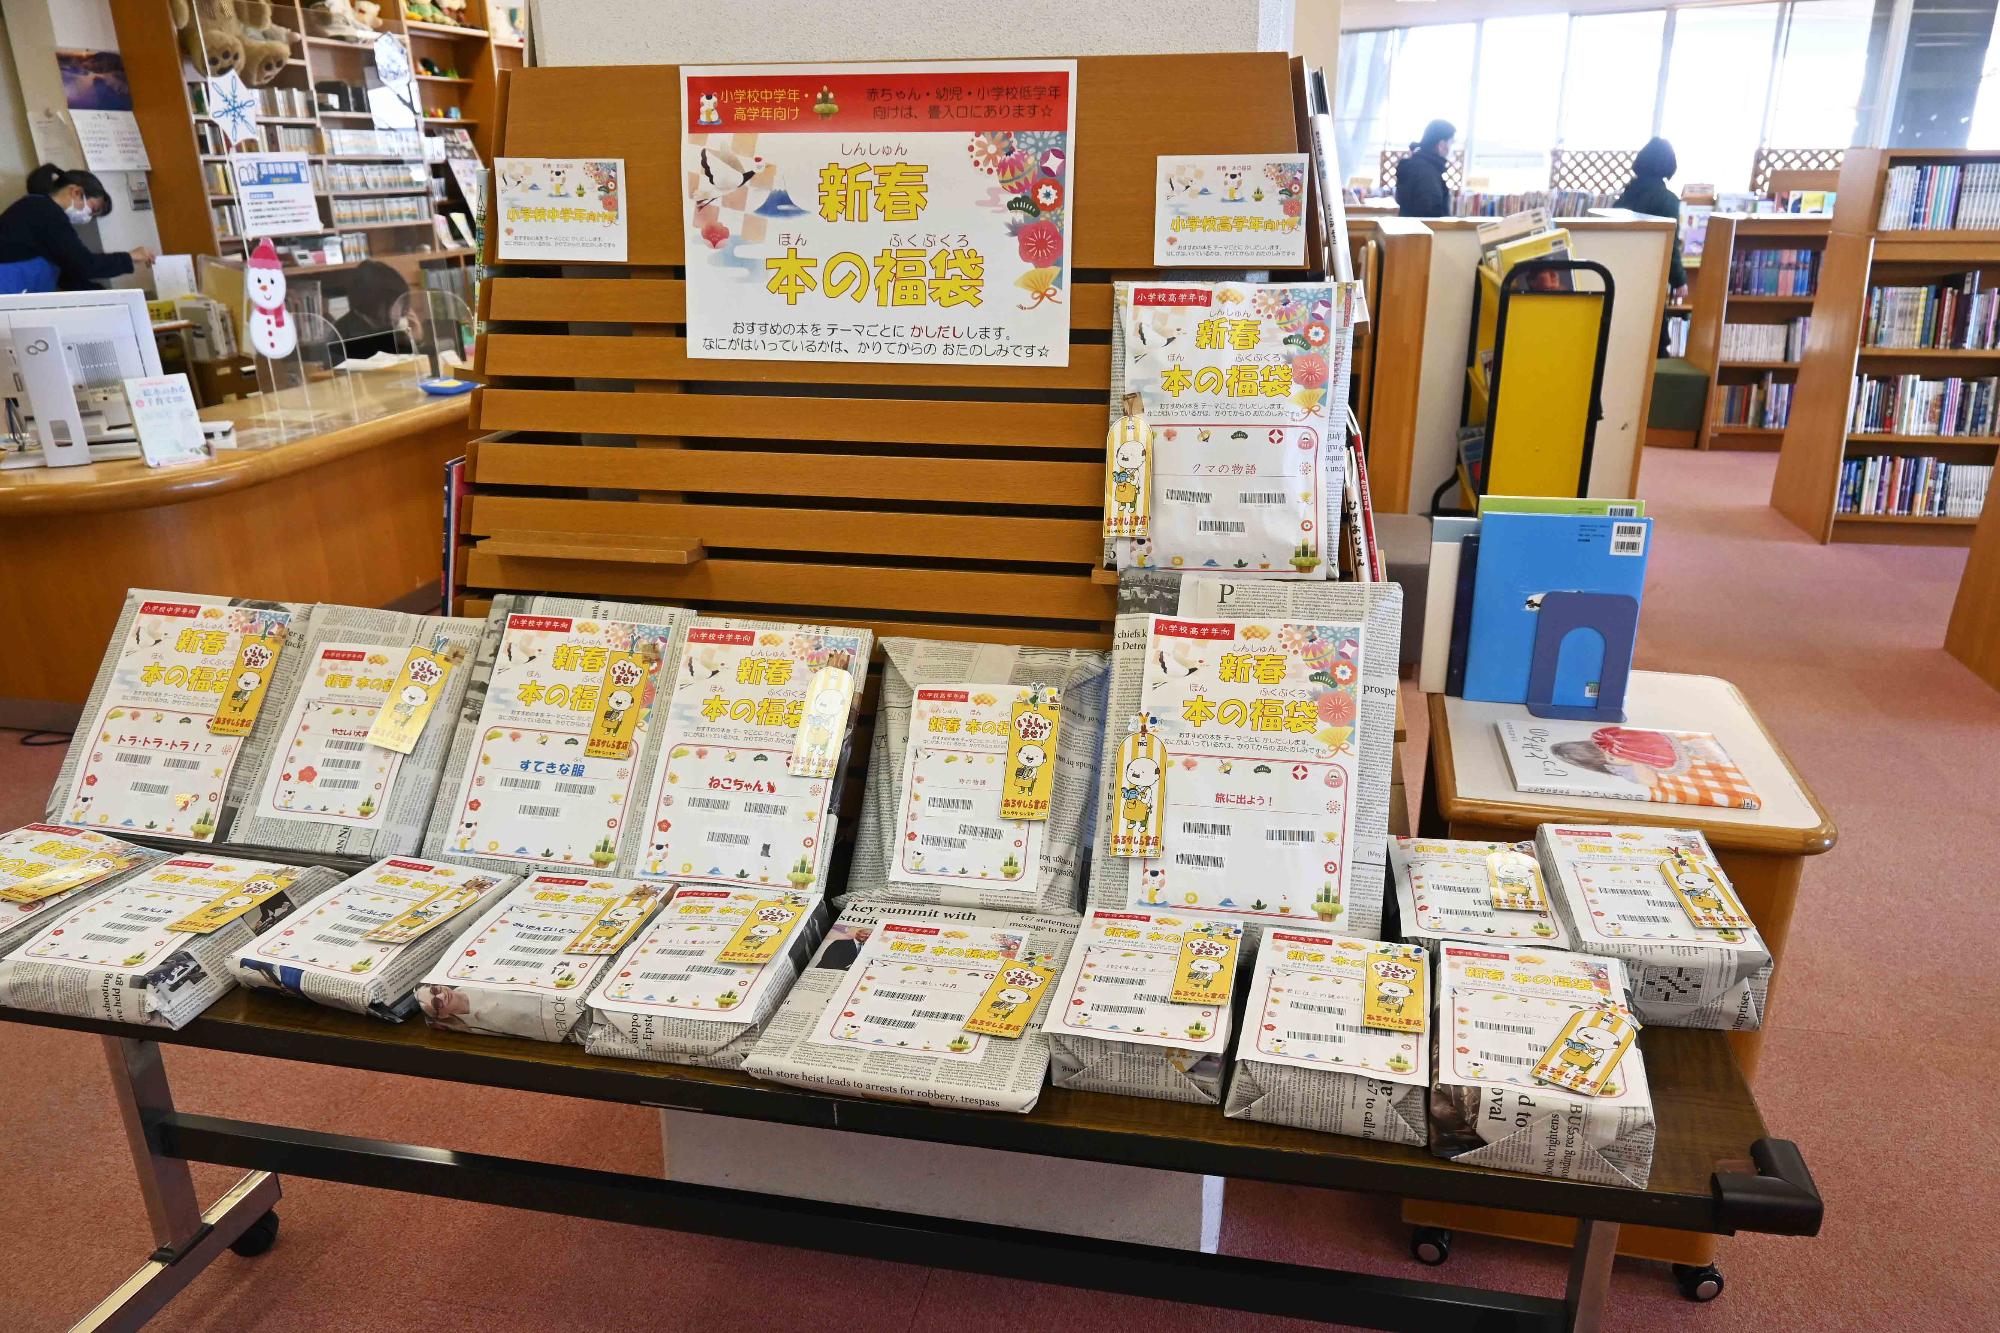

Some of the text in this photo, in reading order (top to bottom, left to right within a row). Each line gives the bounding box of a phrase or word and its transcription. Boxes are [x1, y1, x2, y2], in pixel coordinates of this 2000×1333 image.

[734, 107, 800, 122] 高学年向け
[840, 143, 908, 156] しんしゅん
[819, 163, 928, 222] 新春
[1170, 215, 1287, 233] 小学校高学年向け
[778, 234, 808, 247] ほん
[888, 233, 970, 248] ふくぶくろ
[766, 248, 985, 308] 本の福袋
[1137, 292, 1208, 304] 小学校高学年向
[732, 322, 1012, 341] おすすめの本を テーマごとに かしだしします。
[1195, 318, 1261, 350] 新春
[702, 338, 849, 353] なにがはいっているかは、
[857, 340, 937, 356] かりてからの
[1161, 365, 1293, 397] 本の福袋
[1192, 463, 1257, 475] クマの物語
[1347, 501, 1366, 567] ひげおじさん
[1219, 584, 1235, 604] P
[511, 619, 569, 630] 小学校中学年向
[1117, 628, 1139, 639] chiefs
[1157, 624, 1231, 637] 小学校高学年向
[174, 628, 229, 656] 新春
[690, 632, 751, 643] 小学校中学年向
[552, 643, 609, 673] 新春
[736, 657, 794, 686] 新春
[1219, 653, 1288, 685] 新春
[1182, 695, 1319, 734] 本の福袋
[928, 716, 961, 734] 新春
[520, 759, 586, 777] すてきな服
[708, 776, 763, 793] ねこちゃん
[850, 904, 977, 922] key summit with
[1009, 921, 1046, 931] message
[1036, 917, 1080, 928] statement
[103, 973, 113, 1013] shooting
[113, 988, 122, 1007] held
[746, 1065, 1001, 1109] watch store heist leads to arrests for robbery, trespass
[1366, 1097, 1375, 1109] to
[1363, 1110, 1376, 1128] call
[1516, 1112, 1532, 1127] to
[1545, 1113, 1562, 1156] brightens
